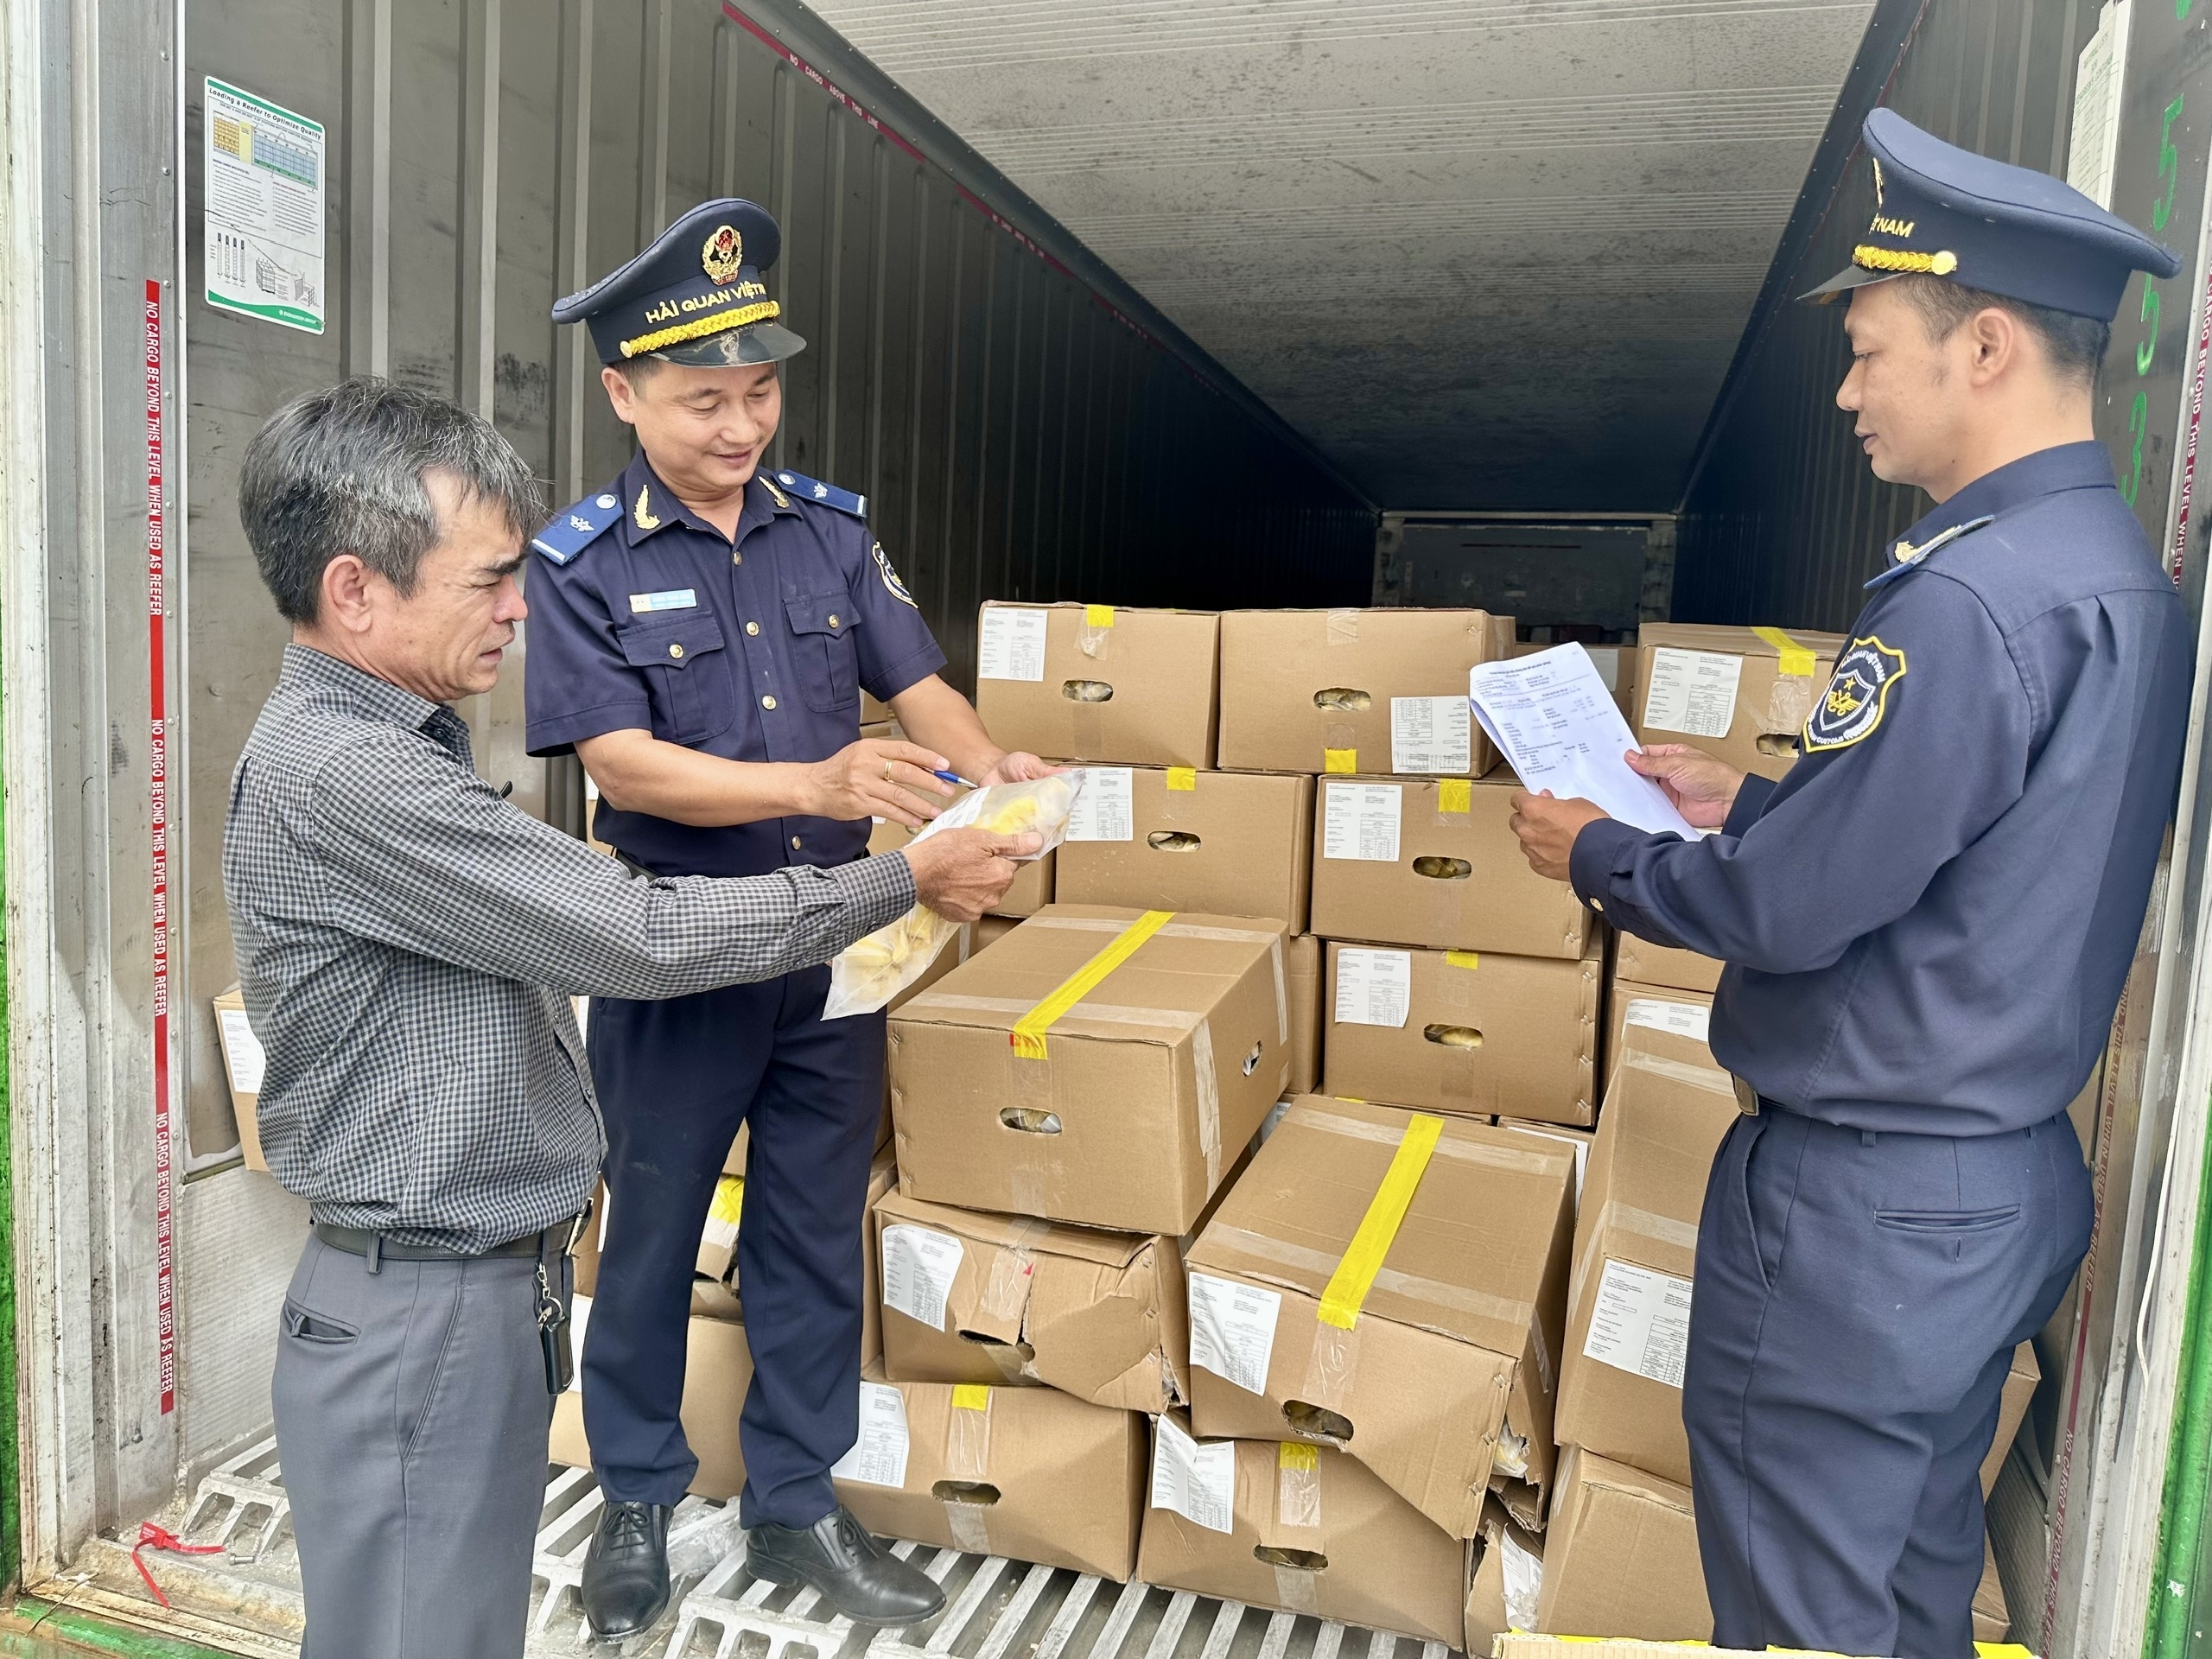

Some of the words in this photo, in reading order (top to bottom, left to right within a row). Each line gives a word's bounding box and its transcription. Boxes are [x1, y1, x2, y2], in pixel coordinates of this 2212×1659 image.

[789, 54, 798, 66] NO
[804, 66, 823, 85] CARGO
[209, 88, 234, 105] Loading
[242, 100, 263, 115] Reefer
[272, 115, 300, 130] Optimize
[300, 126, 321, 140] Quality
[146, 301, 159, 319] NO
[645, 299, 680, 324] HẢI
[681, 289, 732, 312] QUAN
[146, 322, 159, 363] CARGO
[147, 366, 160, 412] BEYOND
[2193, 348, 2209, 415] BEYOND
[147, 416, 161, 442] THIS
[2187, 421, 2199, 458] THIS
[148, 445, 162, 480] LEVEL
[149, 485, 162, 517] WHEN
[2180, 465, 2194, 515] LEVEL
[149, 520, 162, 550] USED
[2174, 521, 2187, 568] WHEN
[149, 554, 162, 569] AS
[149, 573, 163, 616] REEFER
[151, 719, 164, 735] NO
[151, 740, 165, 778] CARGO
[152, 781, 165, 824] BEYOND
[152, 829, 166, 851] THIS
[153, 855, 166, 889] LEVEL
[153, 892, 167, 924] WHEN
[154, 928, 167, 955] USED
[154, 958, 167, 972] AS
[154, 976, 168, 1017] REEFER
[2114, 1024, 2125, 1055] THIS
[2107, 1064, 2120, 1107] LEVEL
[156, 1112, 168, 1128] NO
[2100, 1116, 2113, 1159] WHEN
[156, 1132, 168, 1168] CARGO
[157, 1170, 169, 1212] BEYOND
[2096, 1166, 2107, 1204] USED
[158, 1213, 170, 1237] THIS
[2093, 1208, 2101, 1230] AS
[158, 1239, 170, 1274] LEVEL
[2085, 1233, 2098, 1293] REEFER
[159, 1274, 171, 1307] WHEN
[160, 1307, 172, 1335] USED
[161, 1337, 173, 1356] AS
[161, 1357, 174, 1394] REEFER
[2065, 1431, 2073, 1452] NO
[2059, 1458, 2070, 1509] CARGO
[2053, 1512, 2065, 1572] BEYOND
[2049, 1575, 2057, 1609] THIS
